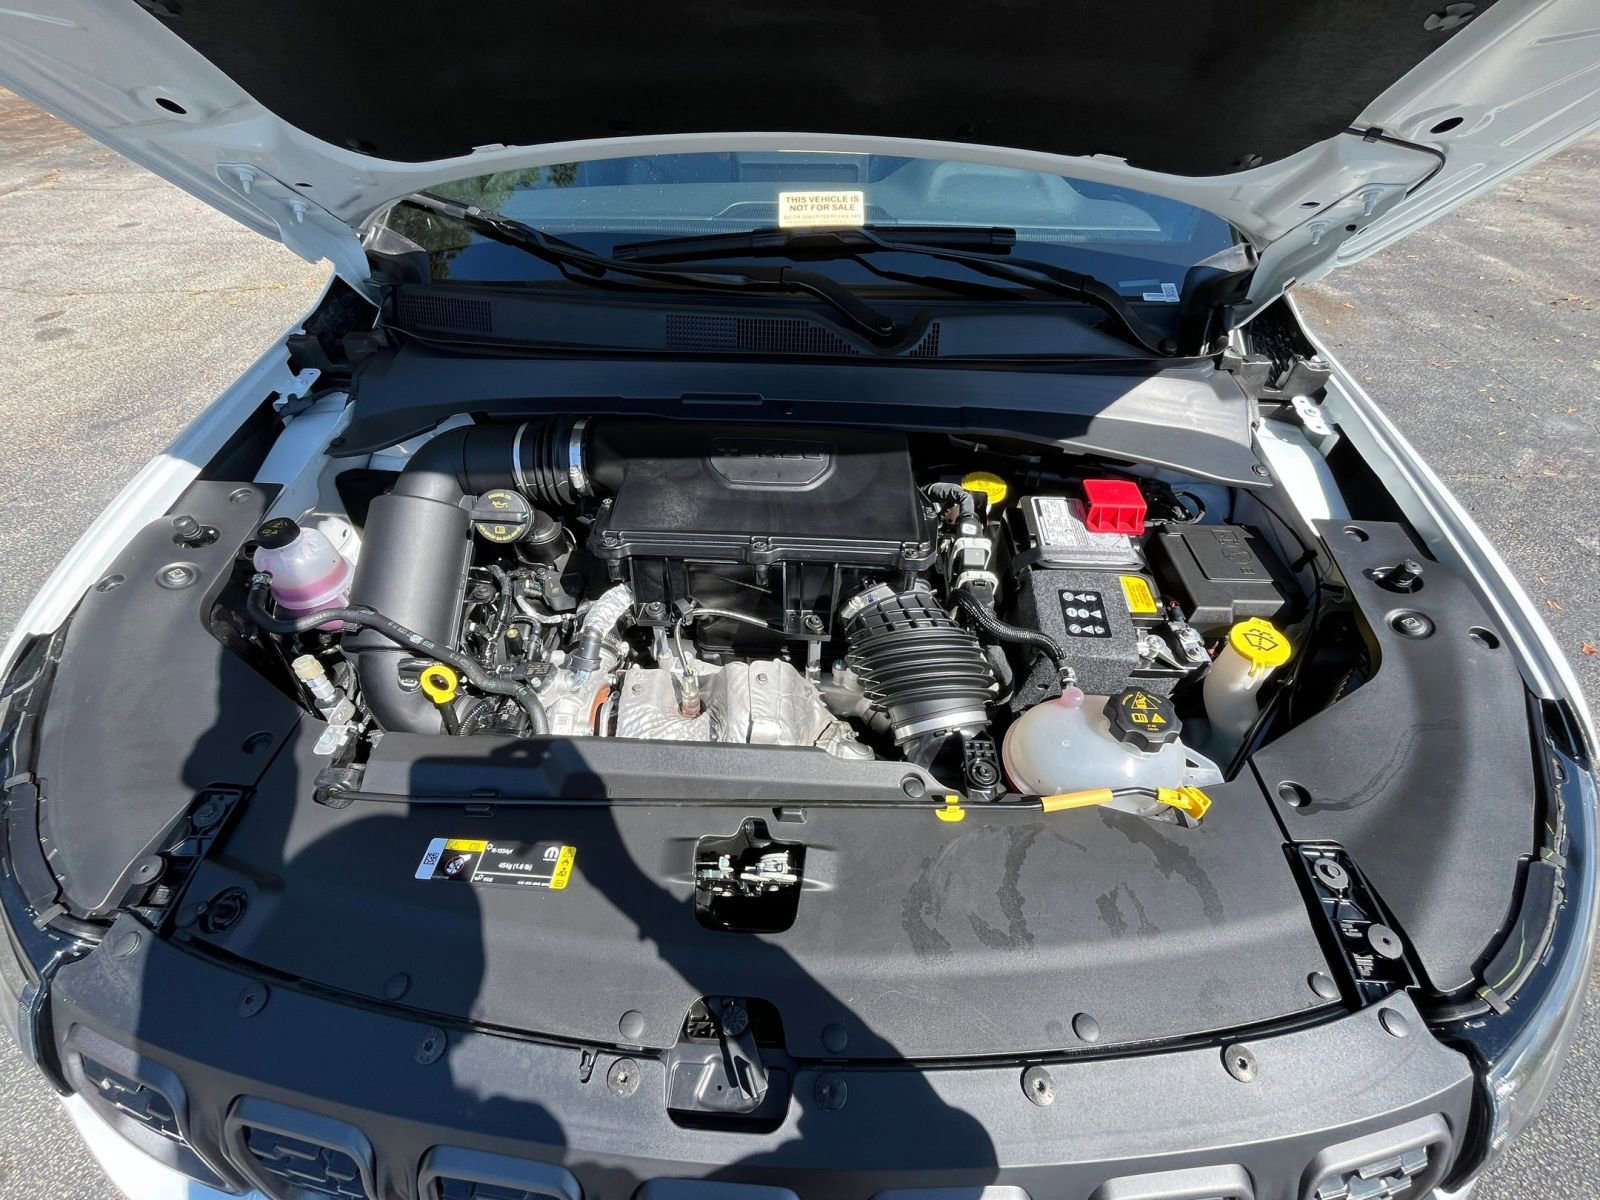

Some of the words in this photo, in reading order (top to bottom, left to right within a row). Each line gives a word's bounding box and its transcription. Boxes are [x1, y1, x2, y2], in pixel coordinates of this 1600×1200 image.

[809, 195, 848, 203] VEHICLE
[851, 195, 859, 203] IS
[832, 203, 855, 211] SALE
